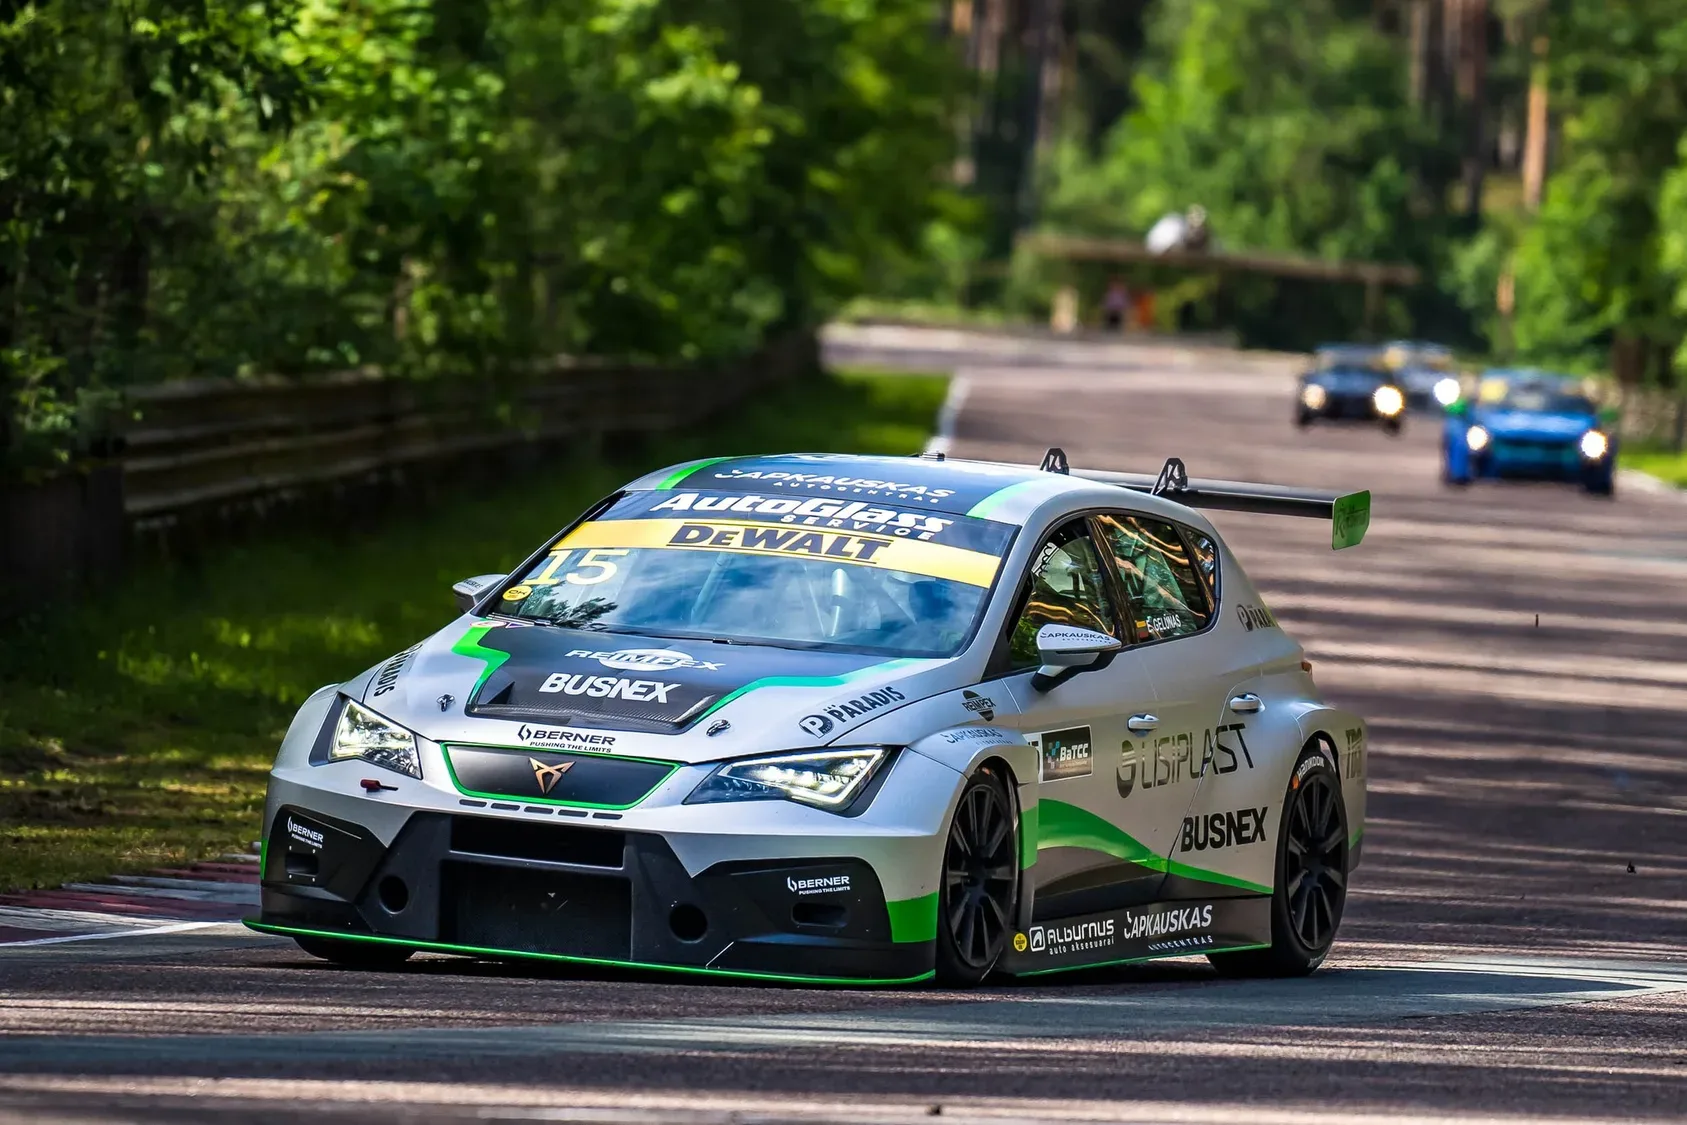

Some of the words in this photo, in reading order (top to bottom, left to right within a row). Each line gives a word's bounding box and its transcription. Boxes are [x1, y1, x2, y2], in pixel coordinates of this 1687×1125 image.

[649, 493, 954, 533] AutoGlass
[780, 514, 936, 541] SERVICE
[522, 549, 629, 586] 15
[565, 650, 726, 670] REIMPEX
[539, 672, 681, 703] BUSNEX
[827, 686, 905, 723] PARADIS
[962, 697, 996, 712] REIMPEX
[530, 741, 565, 749] PUSHING
[533, 730, 616, 746] BERNER
[1060, 743, 1088, 761] BaTCC
[293, 823, 324, 843] BERNER
[1181, 807, 1268, 852] BUSNEX
[798, 876, 850, 889] BERNER
[1049, 944, 1067, 955] auto
[1071, 936, 1114, 951] aksesuarai
